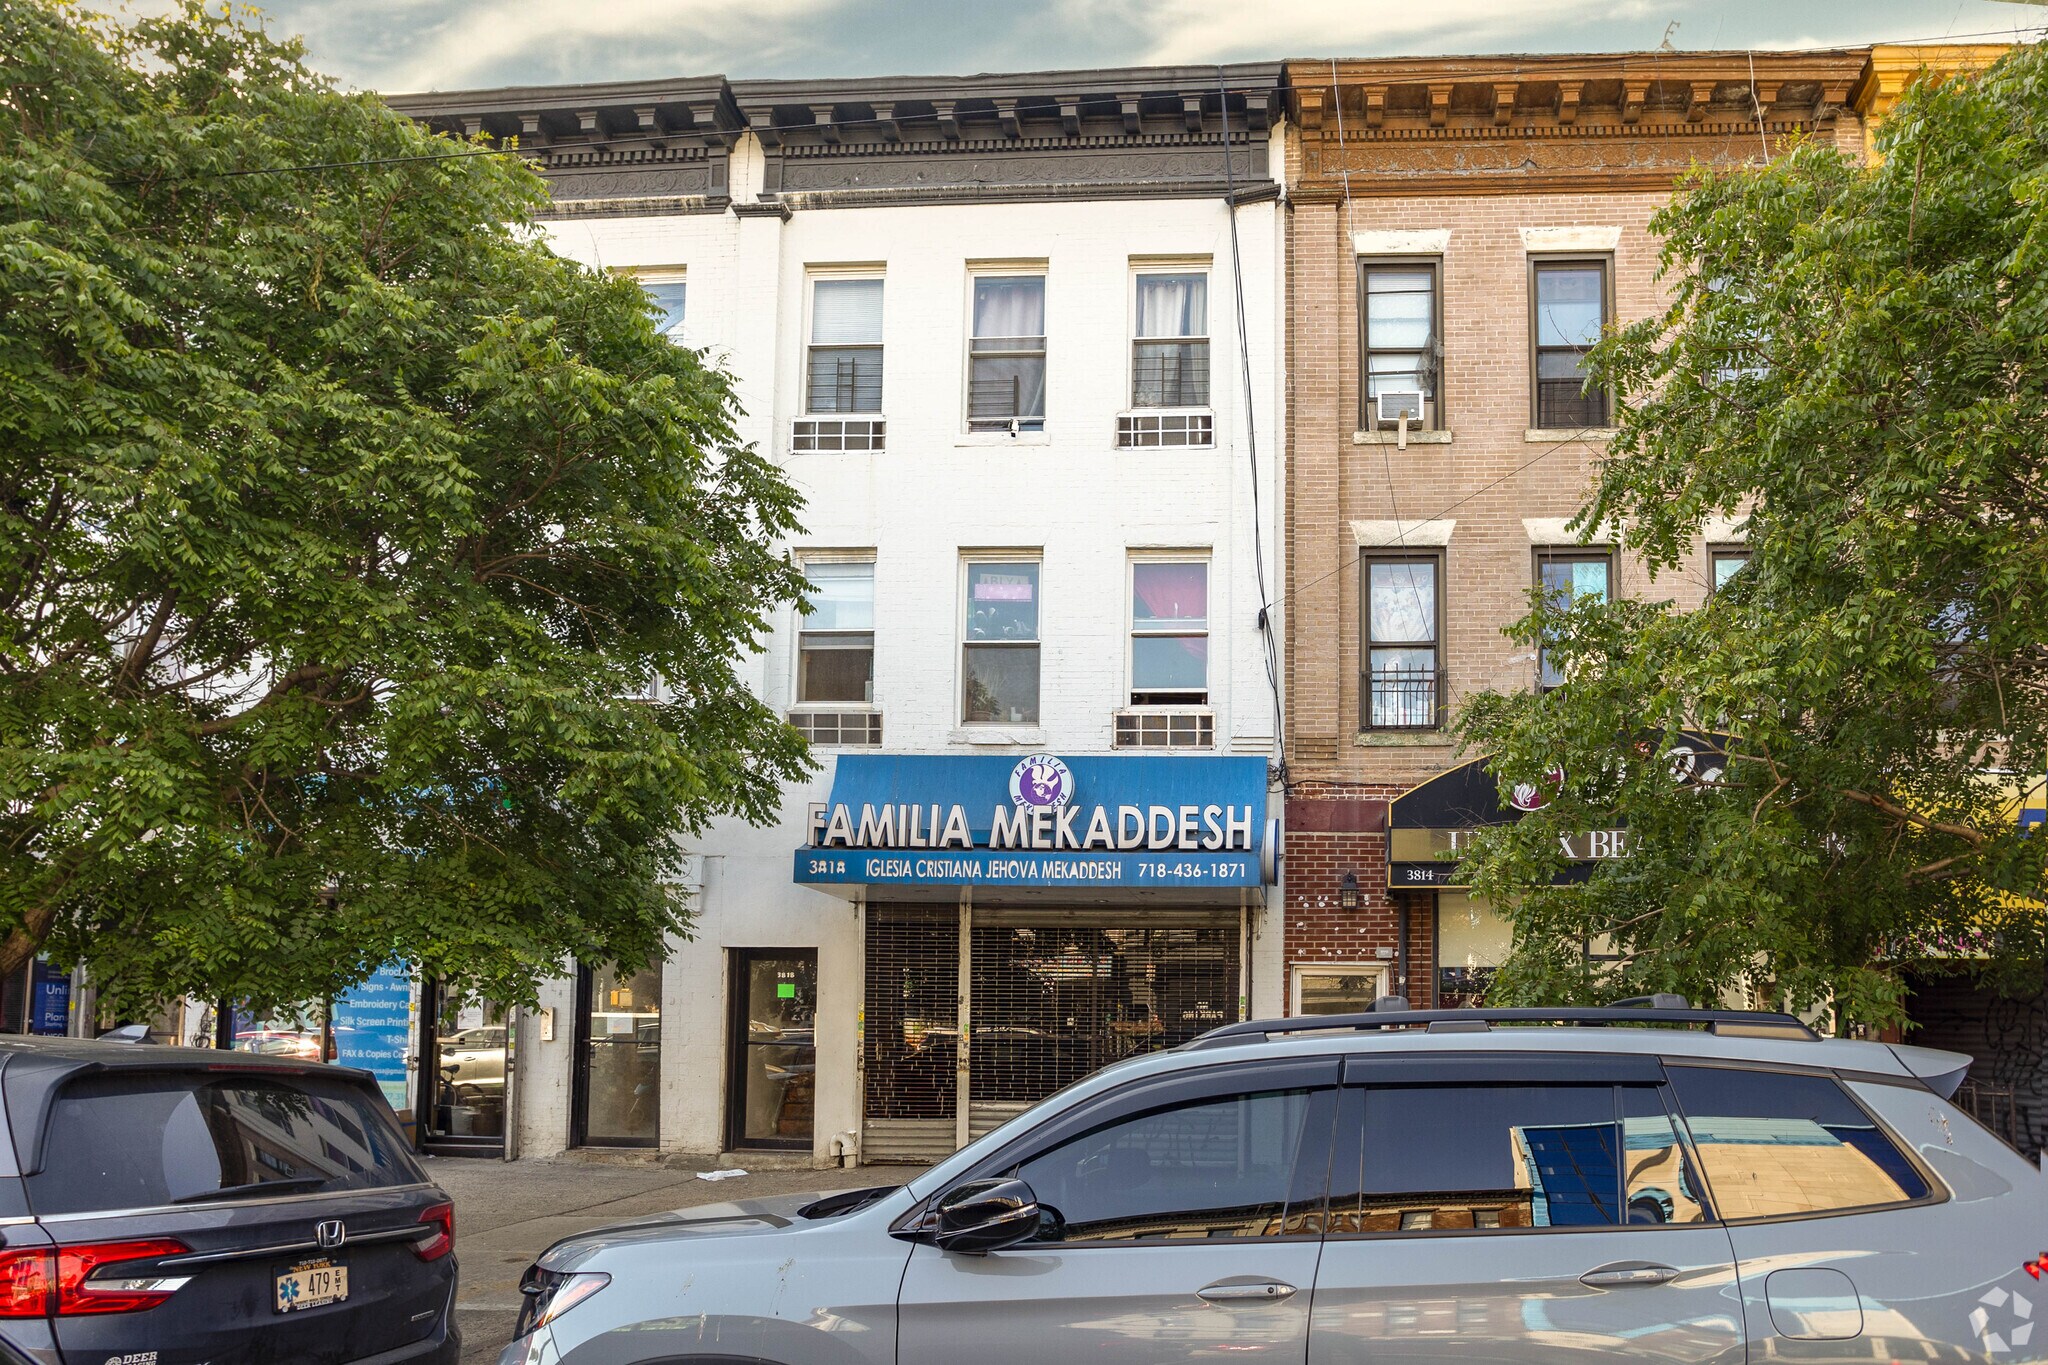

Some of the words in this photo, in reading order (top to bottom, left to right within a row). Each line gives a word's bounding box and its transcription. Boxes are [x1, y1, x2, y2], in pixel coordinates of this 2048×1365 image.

[1015, 756, 1067, 777] FAMILIA
[807, 802, 974, 849] FAMILIA
[988, 804, 1252, 850] MEKADDESH
[809, 860, 846, 875] 3818
[866, 858, 912, 878] IGLESIA
[916, 859, 982, 879] CRISTIANA
[985, 860, 1039, 879] JEHOVA
[1042, 860, 1122, 880] MEKADDESH
[1138, 862, 1246, 879] 718-436-1871
[1407, 869, 1434, 881] 3814
[361, 983, 384, 992] Signs
[349, 1000, 397, 1010] Embroidery
[340, 1016, 355, 1026] Silk
[357, 1016, 385, 1026] Screen
[342, 1049, 357, 1057] FAX
[366, 1050, 391, 1059] Copies
[308, 1271, 330, 1296] 479
[123, 1351, 158, 1364] DEER
